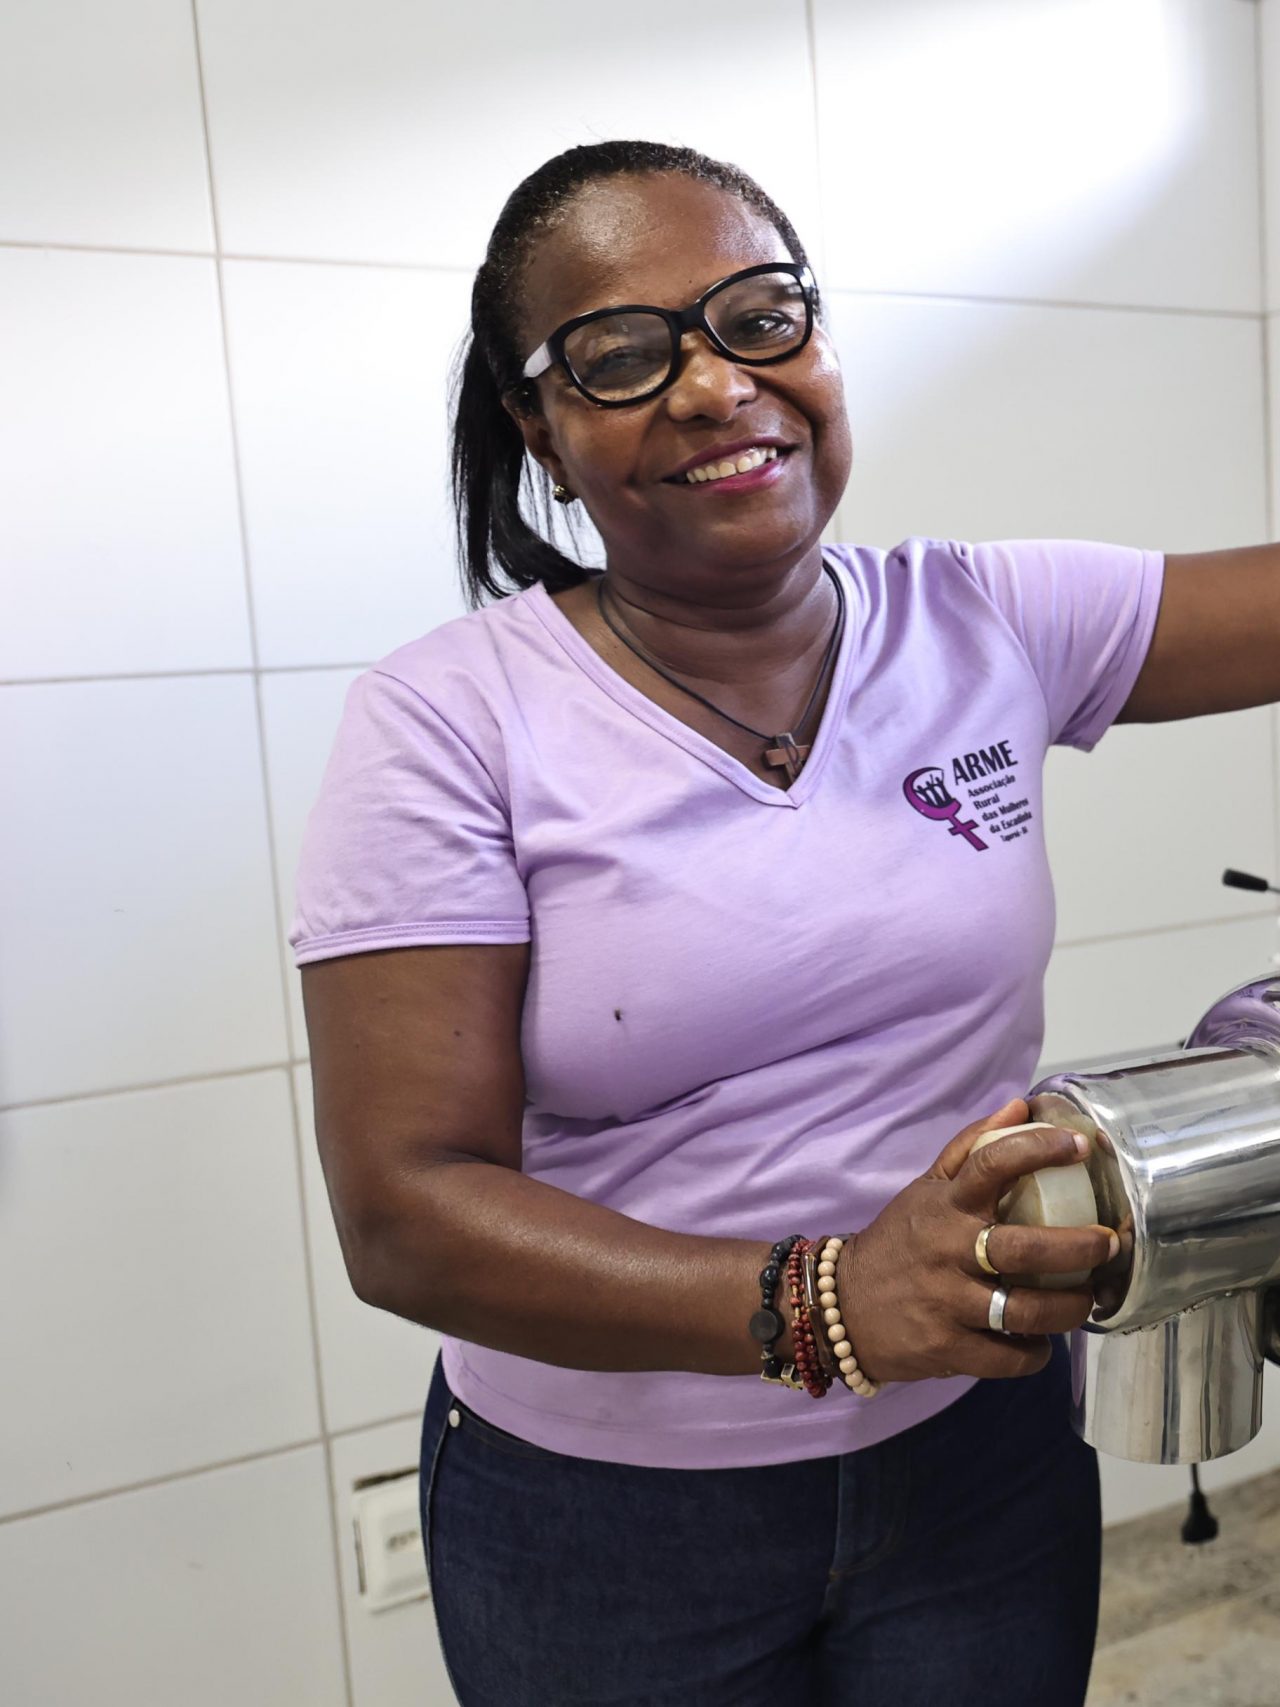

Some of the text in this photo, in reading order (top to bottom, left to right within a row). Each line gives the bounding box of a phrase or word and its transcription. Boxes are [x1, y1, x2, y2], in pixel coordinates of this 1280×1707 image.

[952, 740, 1018, 786] ARME
[968, 774, 1016, 798] Associação
[973, 793, 1000, 810] Rural
[982, 811, 999, 821] das
[990, 824, 1001, 833] da
